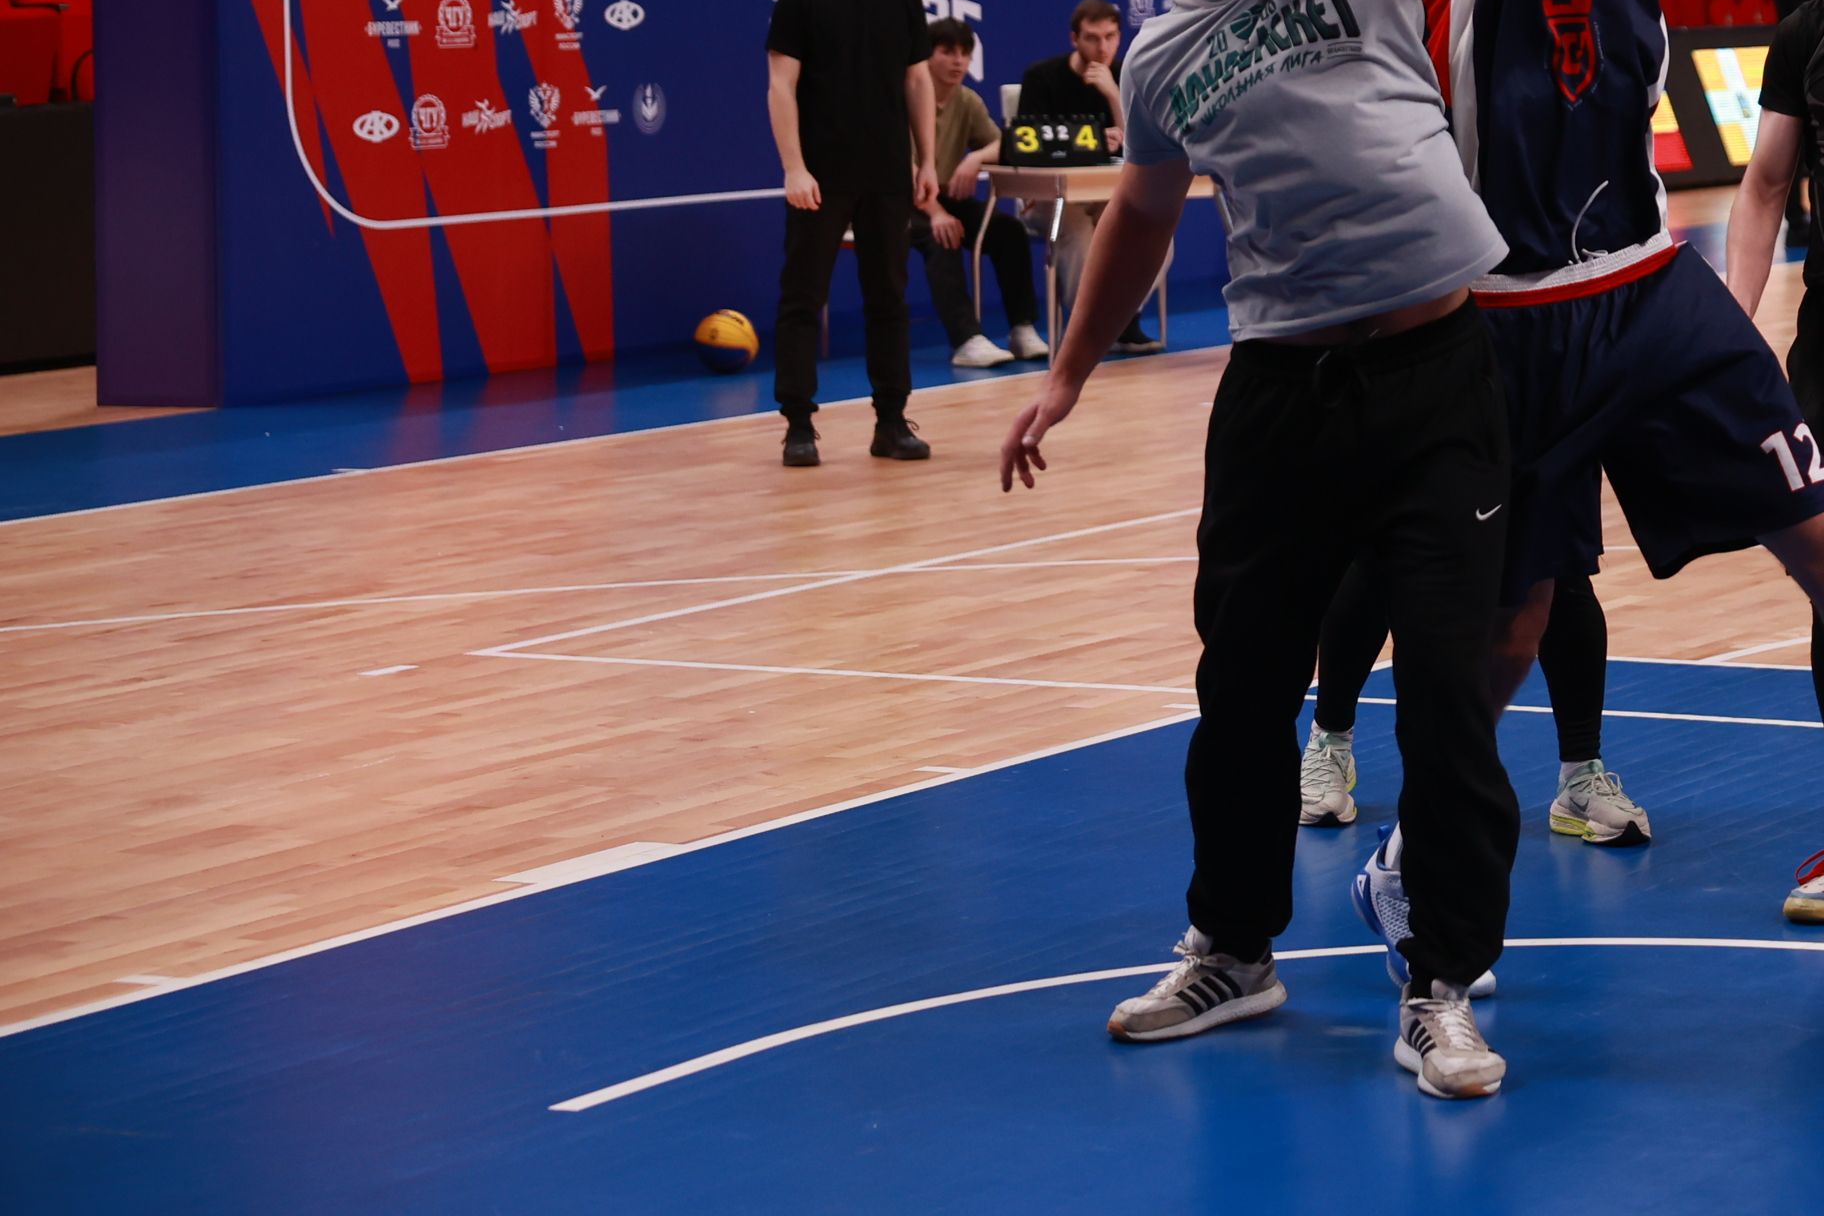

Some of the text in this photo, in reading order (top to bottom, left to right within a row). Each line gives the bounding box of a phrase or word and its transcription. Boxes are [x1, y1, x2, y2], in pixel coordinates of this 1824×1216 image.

[1279, 49, 1324, 73] ЛИГА
[1014, 125, 1040, 153] 3
[1074, 124, 1099, 151] 4
